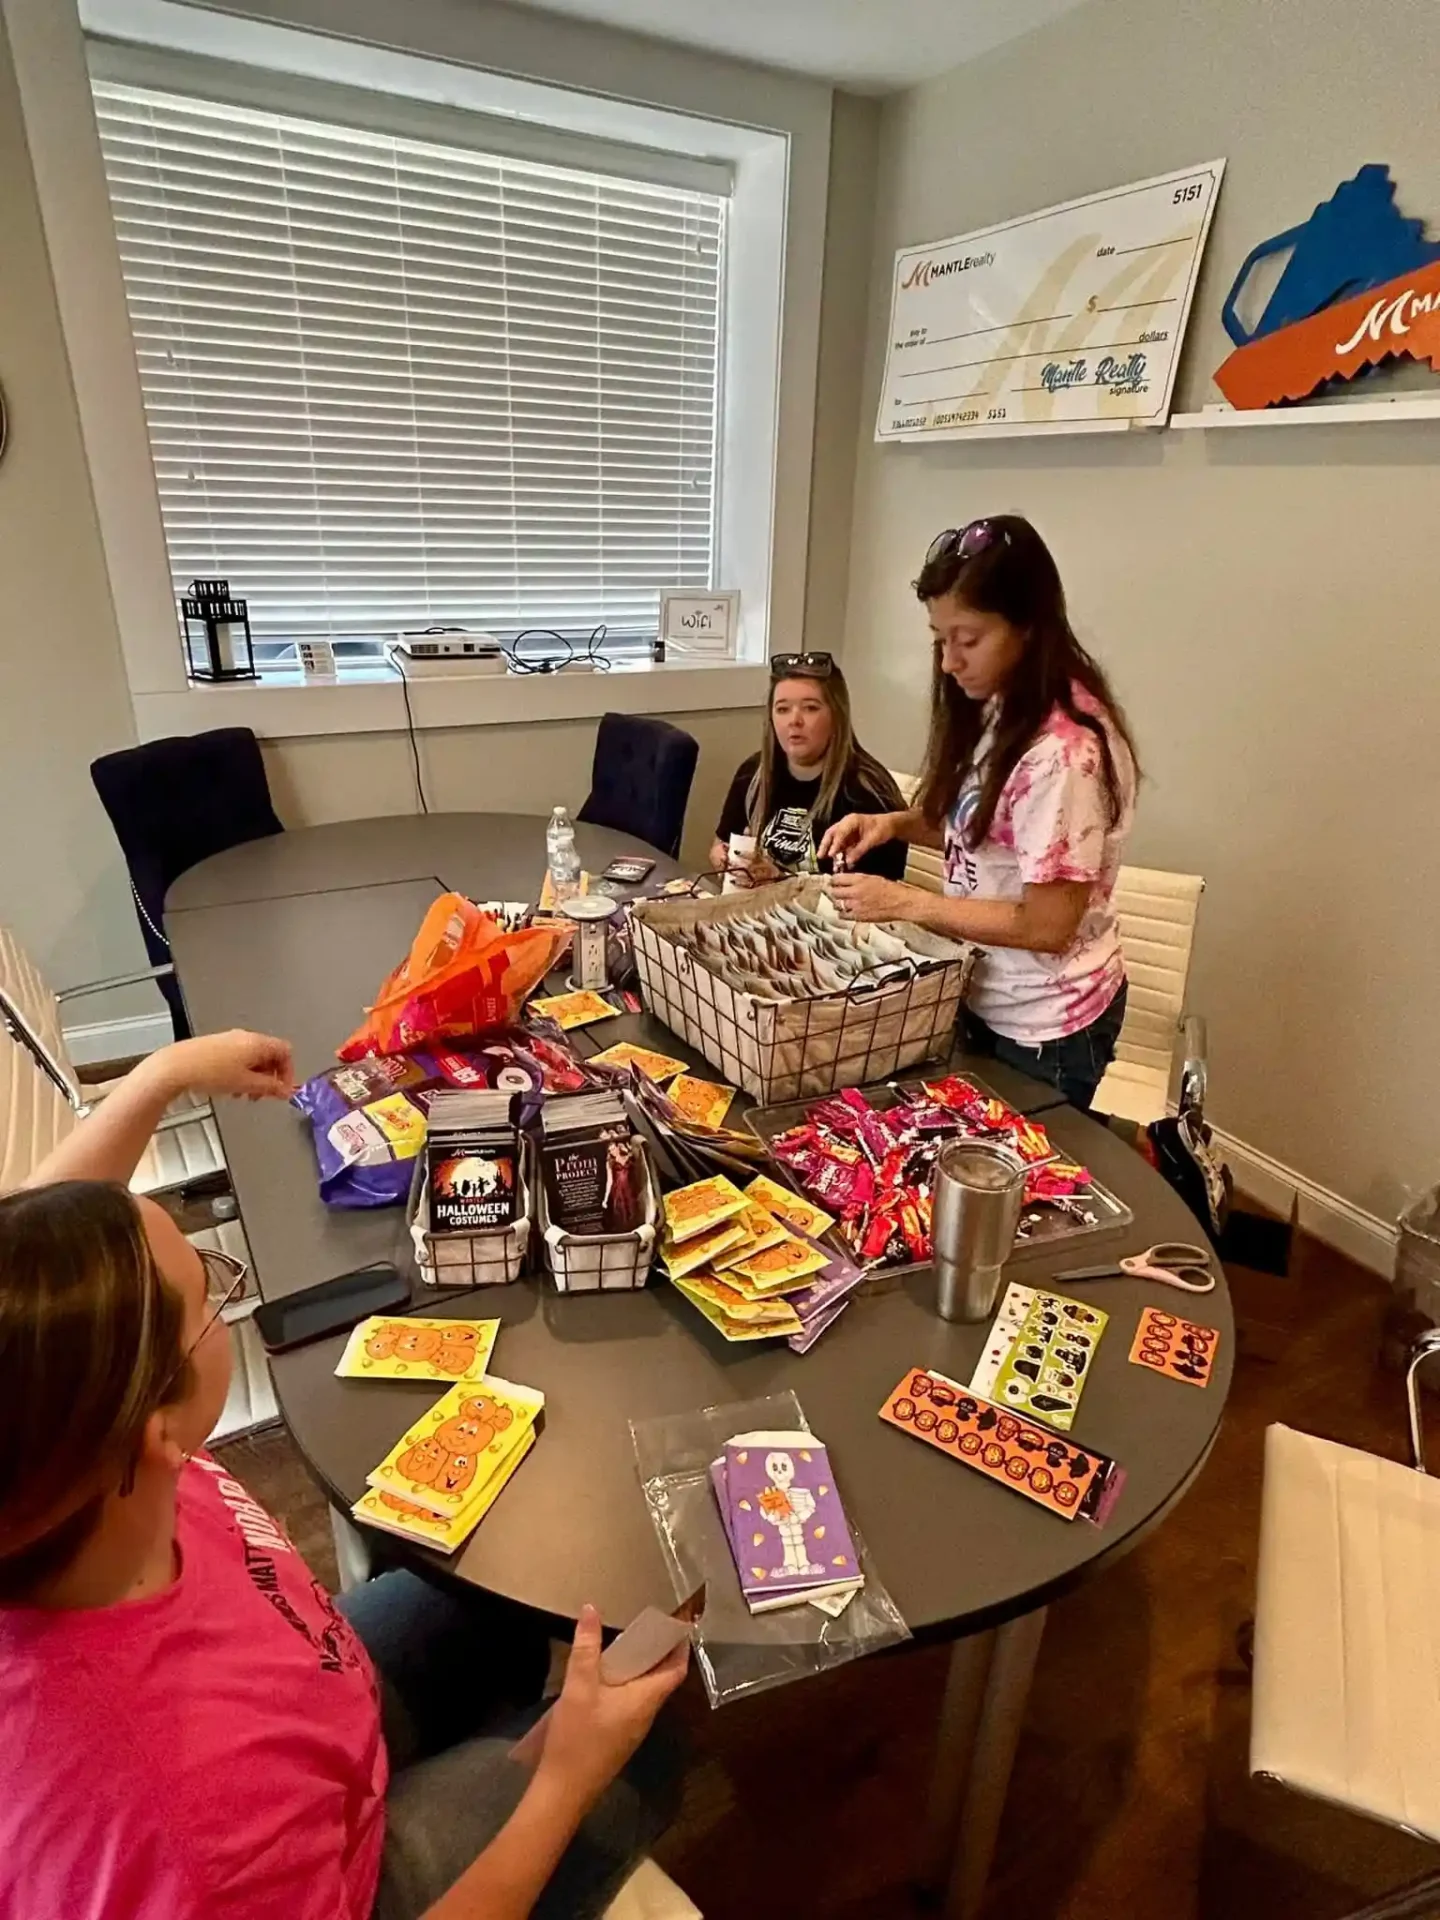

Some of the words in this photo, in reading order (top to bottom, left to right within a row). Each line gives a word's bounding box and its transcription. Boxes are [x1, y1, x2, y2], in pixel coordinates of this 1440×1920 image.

[1172, 184, 1203, 204] 5151
[1096, 246, 1116, 257] date
[1138, 331, 1168, 342] dollars
[1041, 359, 1087, 393] Mantle
[1095, 353, 1146, 386] Realty
[1109, 385, 1148, 396] signature
[554, 1157, 598, 1173] Prom
[556, 1168, 598, 1180] PROJECT
[436, 1202, 510, 1219] HALLOWEEN
[449, 1214, 499, 1226] COSTUMES
